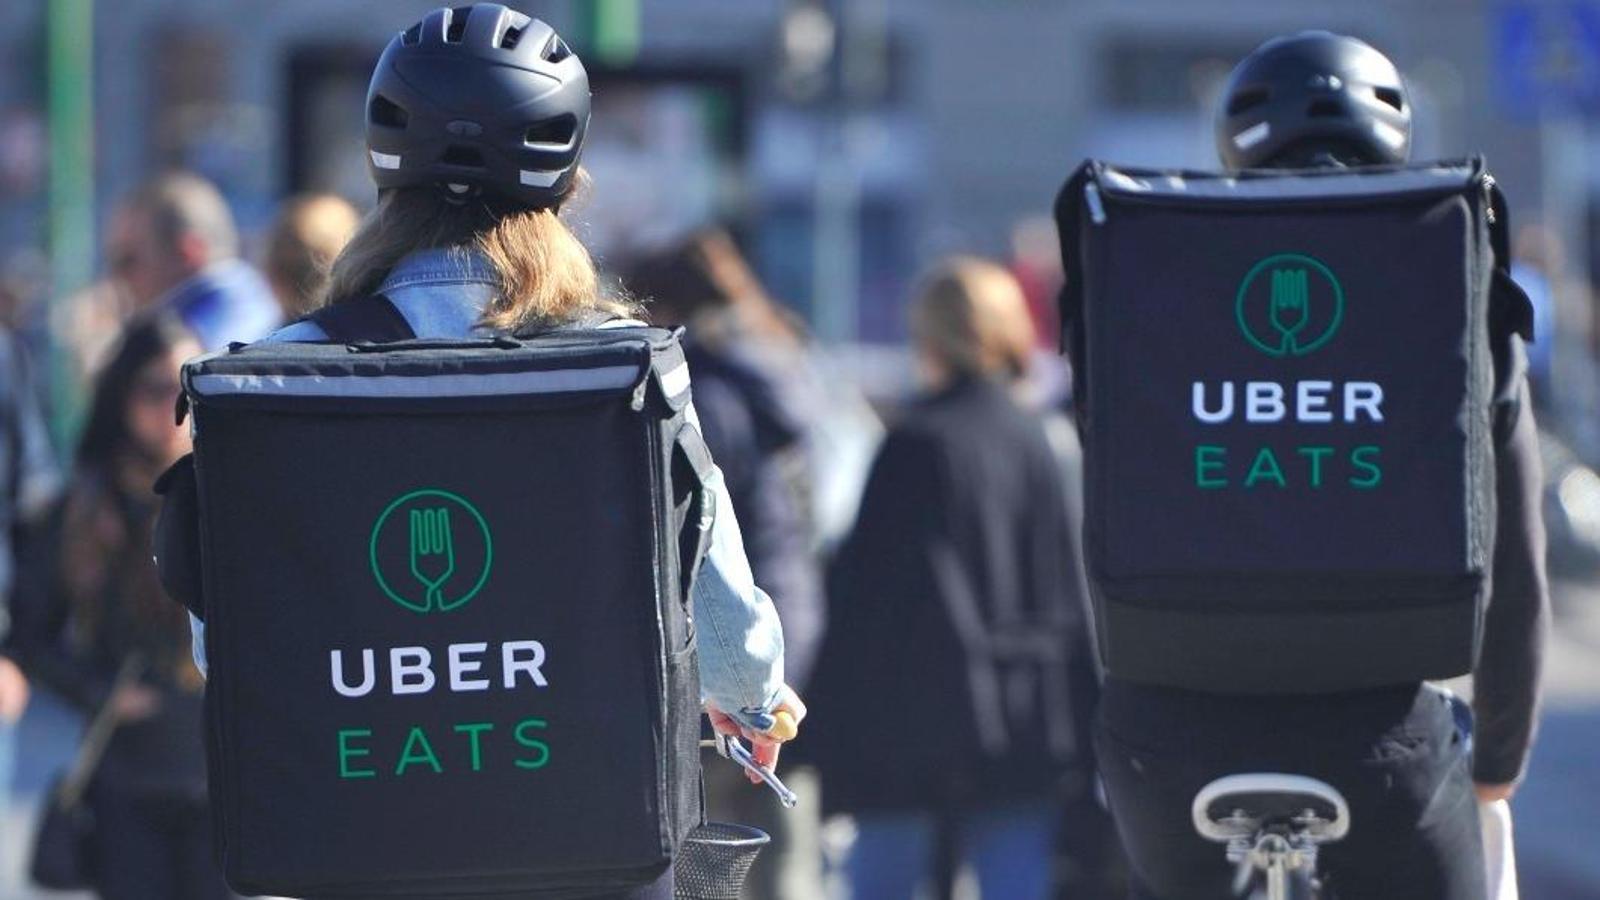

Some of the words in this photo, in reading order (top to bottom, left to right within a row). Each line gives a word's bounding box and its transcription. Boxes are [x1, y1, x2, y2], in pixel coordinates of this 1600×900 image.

[1192, 381, 1384, 423] UBER
[1195, 445, 1383, 489] EATS
[330, 640, 548, 697] UBER
[337, 719, 551, 778] EATS
